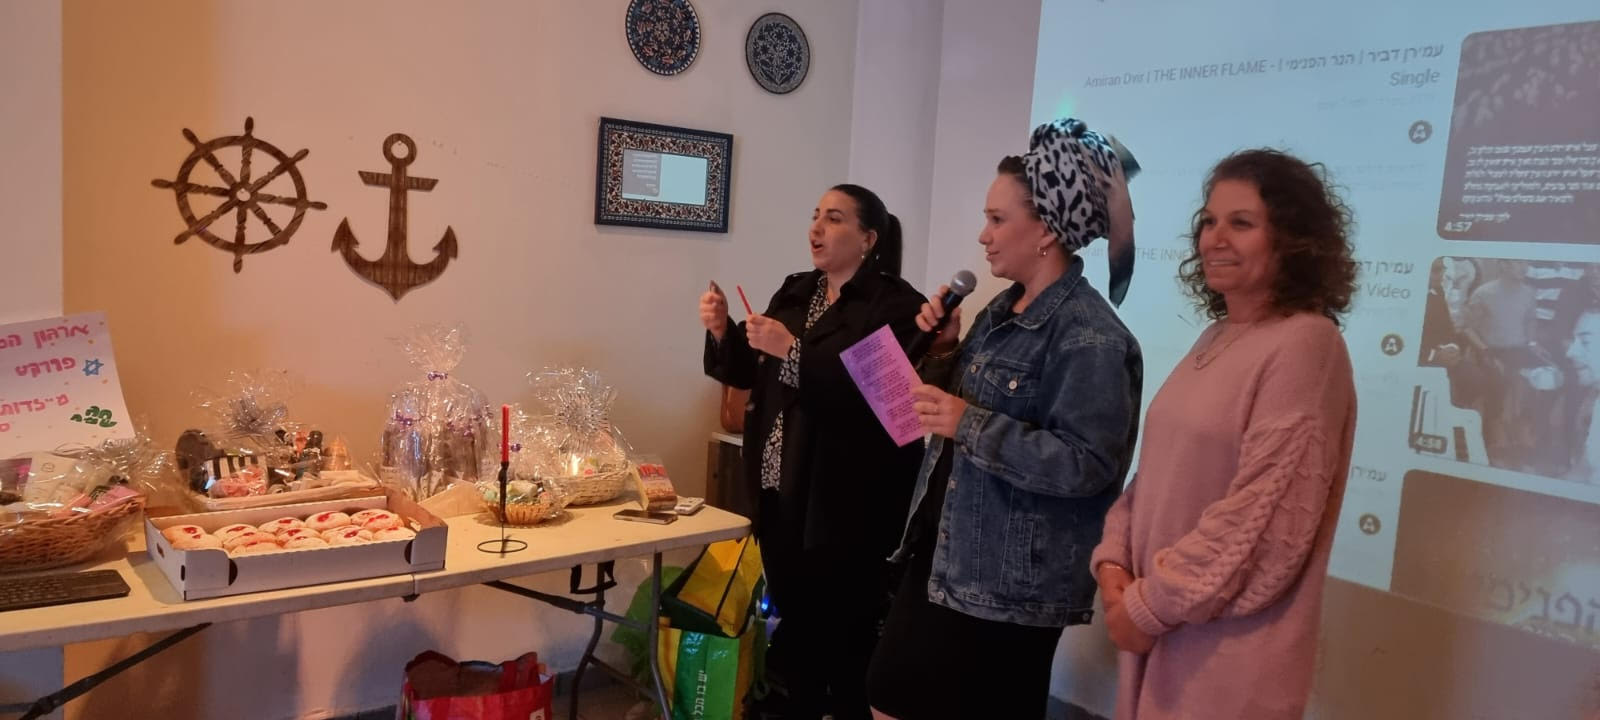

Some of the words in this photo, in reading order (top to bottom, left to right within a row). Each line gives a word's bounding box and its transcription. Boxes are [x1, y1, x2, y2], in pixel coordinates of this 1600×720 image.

[1154, 68, 1176, 81] THE
[1179, 64, 1219, 80] INNER
[1220, 59, 1268, 76] FLAME
[1389, 68, 1440, 88] Single
[1444, 221, 1473, 232] 4:57
[1137, 248, 1158, 260] THE
[1367, 282, 1410, 299] Video
[697, 669, 708, 682] יש
[696, 685, 706, 695] בו
